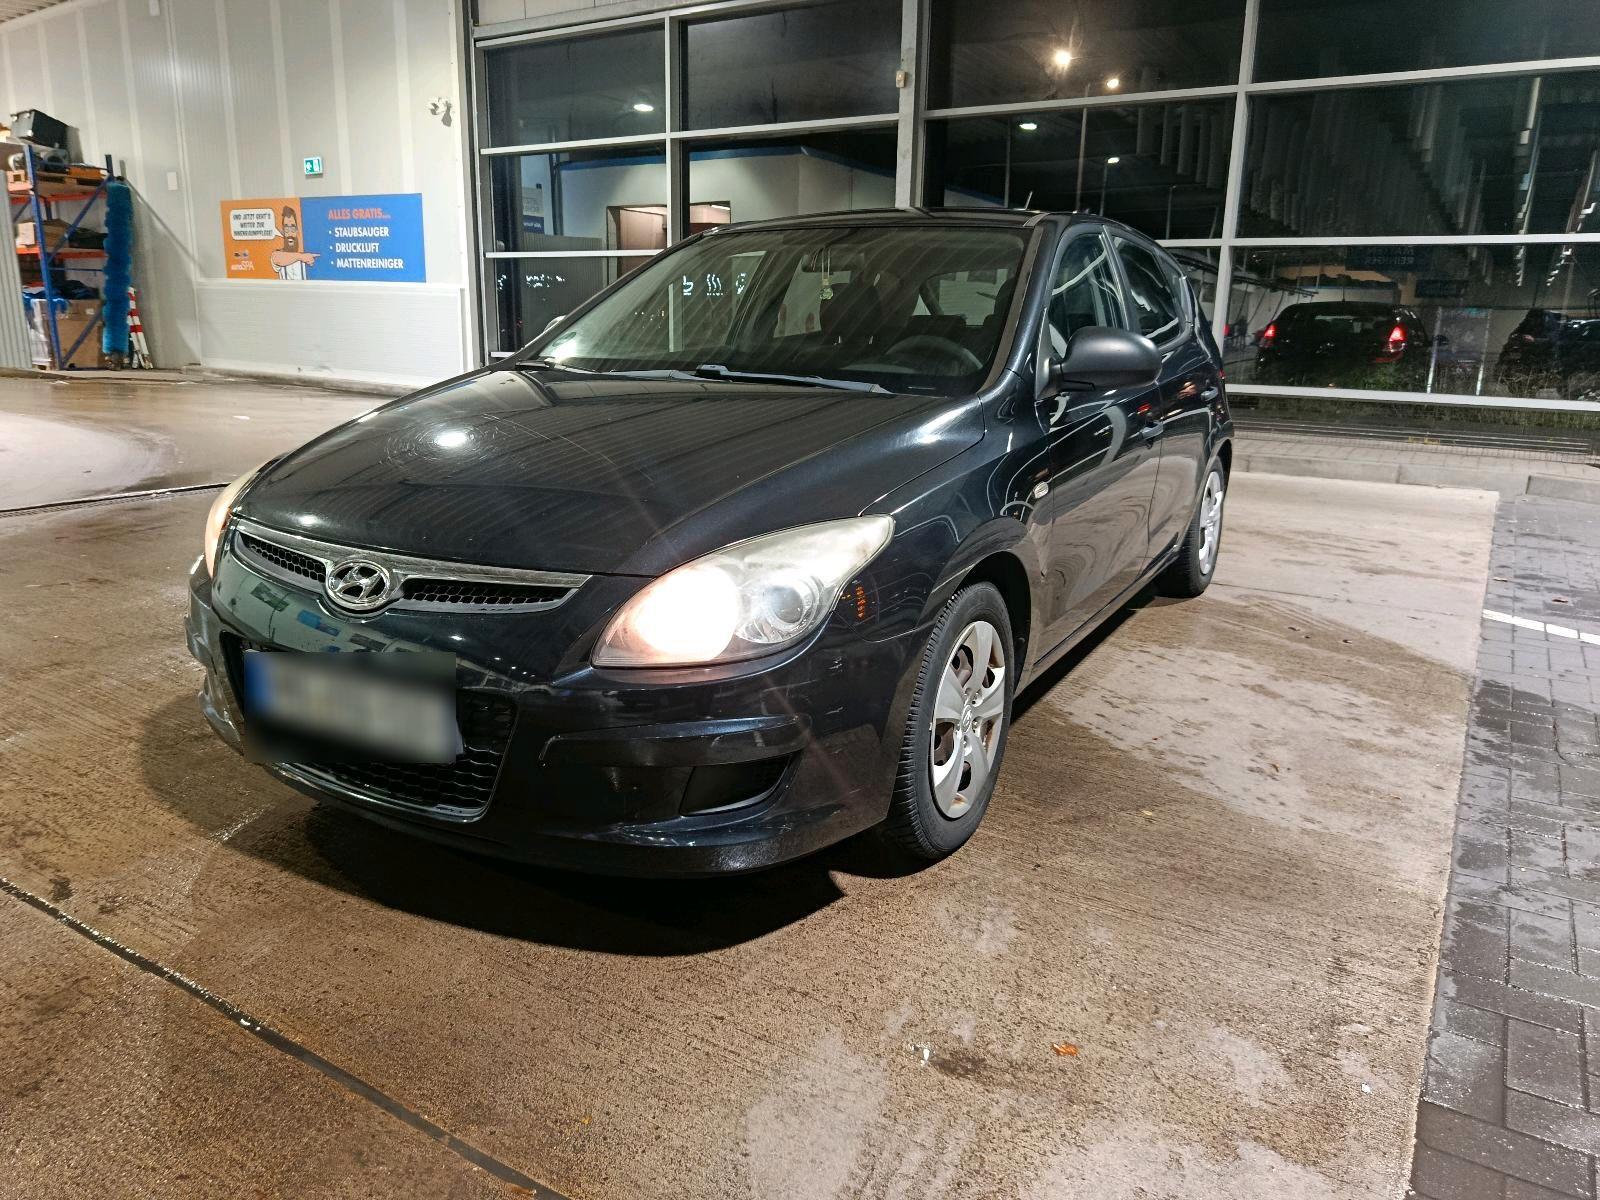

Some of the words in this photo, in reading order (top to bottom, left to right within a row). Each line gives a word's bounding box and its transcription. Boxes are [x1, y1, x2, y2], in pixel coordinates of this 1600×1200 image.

[328, 209, 350, 220] ALLES
[334, 226, 389, 238] STAUBSAUGER
[335, 243, 380, 253] DRUCKLUFT
[336, 258, 404, 269] MATTENREINIGER
